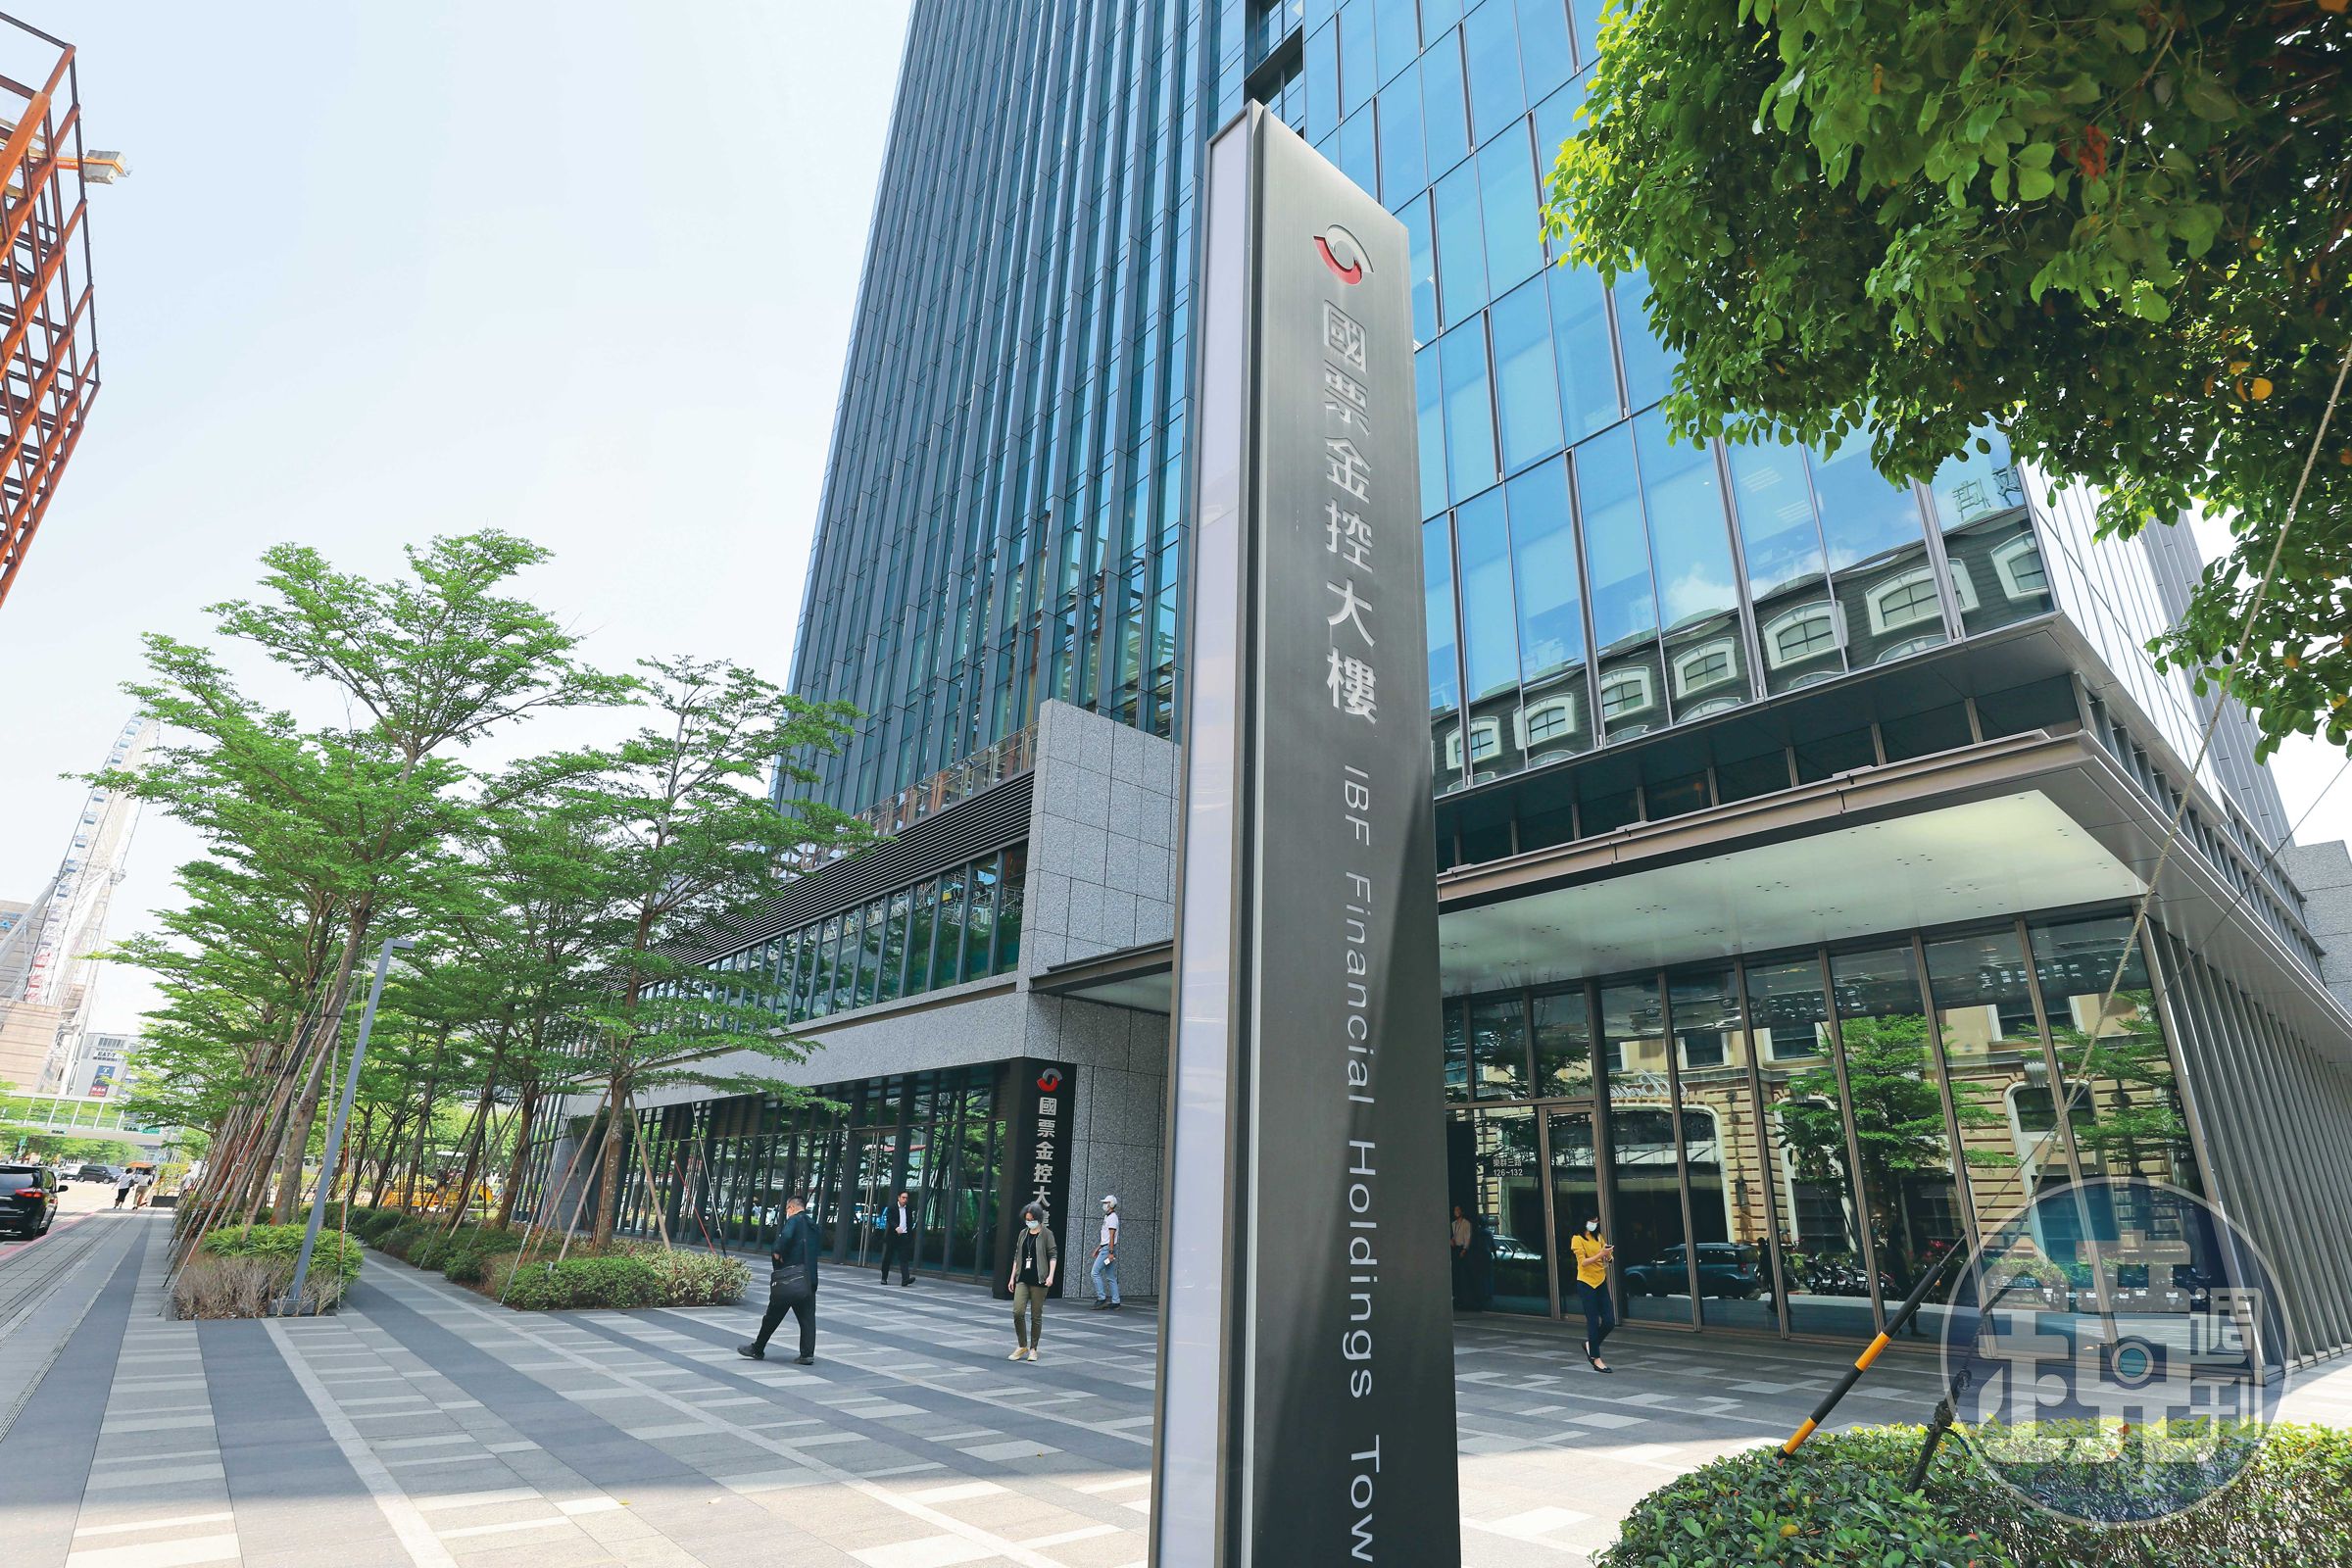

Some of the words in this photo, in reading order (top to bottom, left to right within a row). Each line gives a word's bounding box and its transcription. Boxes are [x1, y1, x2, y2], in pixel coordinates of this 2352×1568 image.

[1324, 299, 1377, 725] 國票金控大樓
[1345, 763, 1369, 847] IBF
[1346, 870, 1375, 1104] Financial
[1343, 1140, 1378, 1398] Holdings
[1350, 1434, 1380, 1563] Tow
